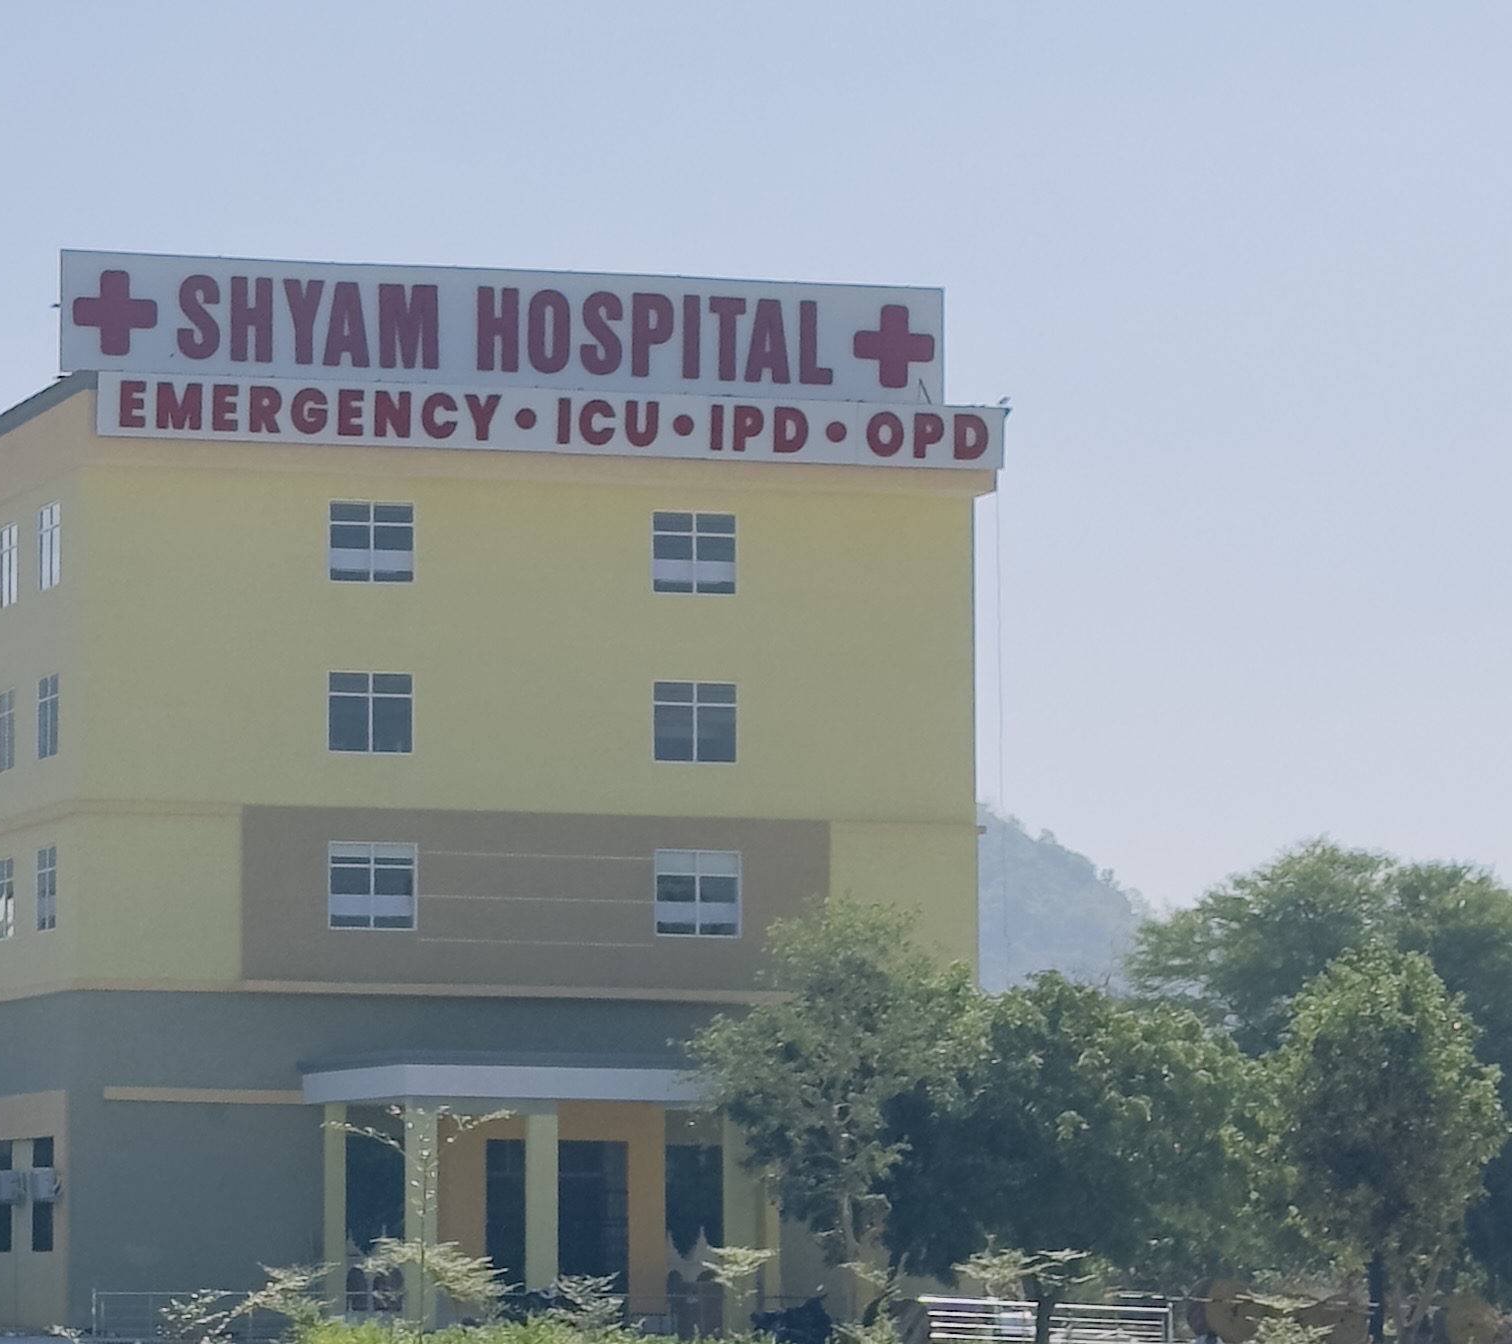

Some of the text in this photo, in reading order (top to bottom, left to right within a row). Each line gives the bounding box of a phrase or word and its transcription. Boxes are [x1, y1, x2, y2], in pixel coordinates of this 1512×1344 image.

[176, 274, 834, 385] SHYAM HOSPITAL
[118, 380, 989, 460] EMERGENCY ICU IPD OPD
